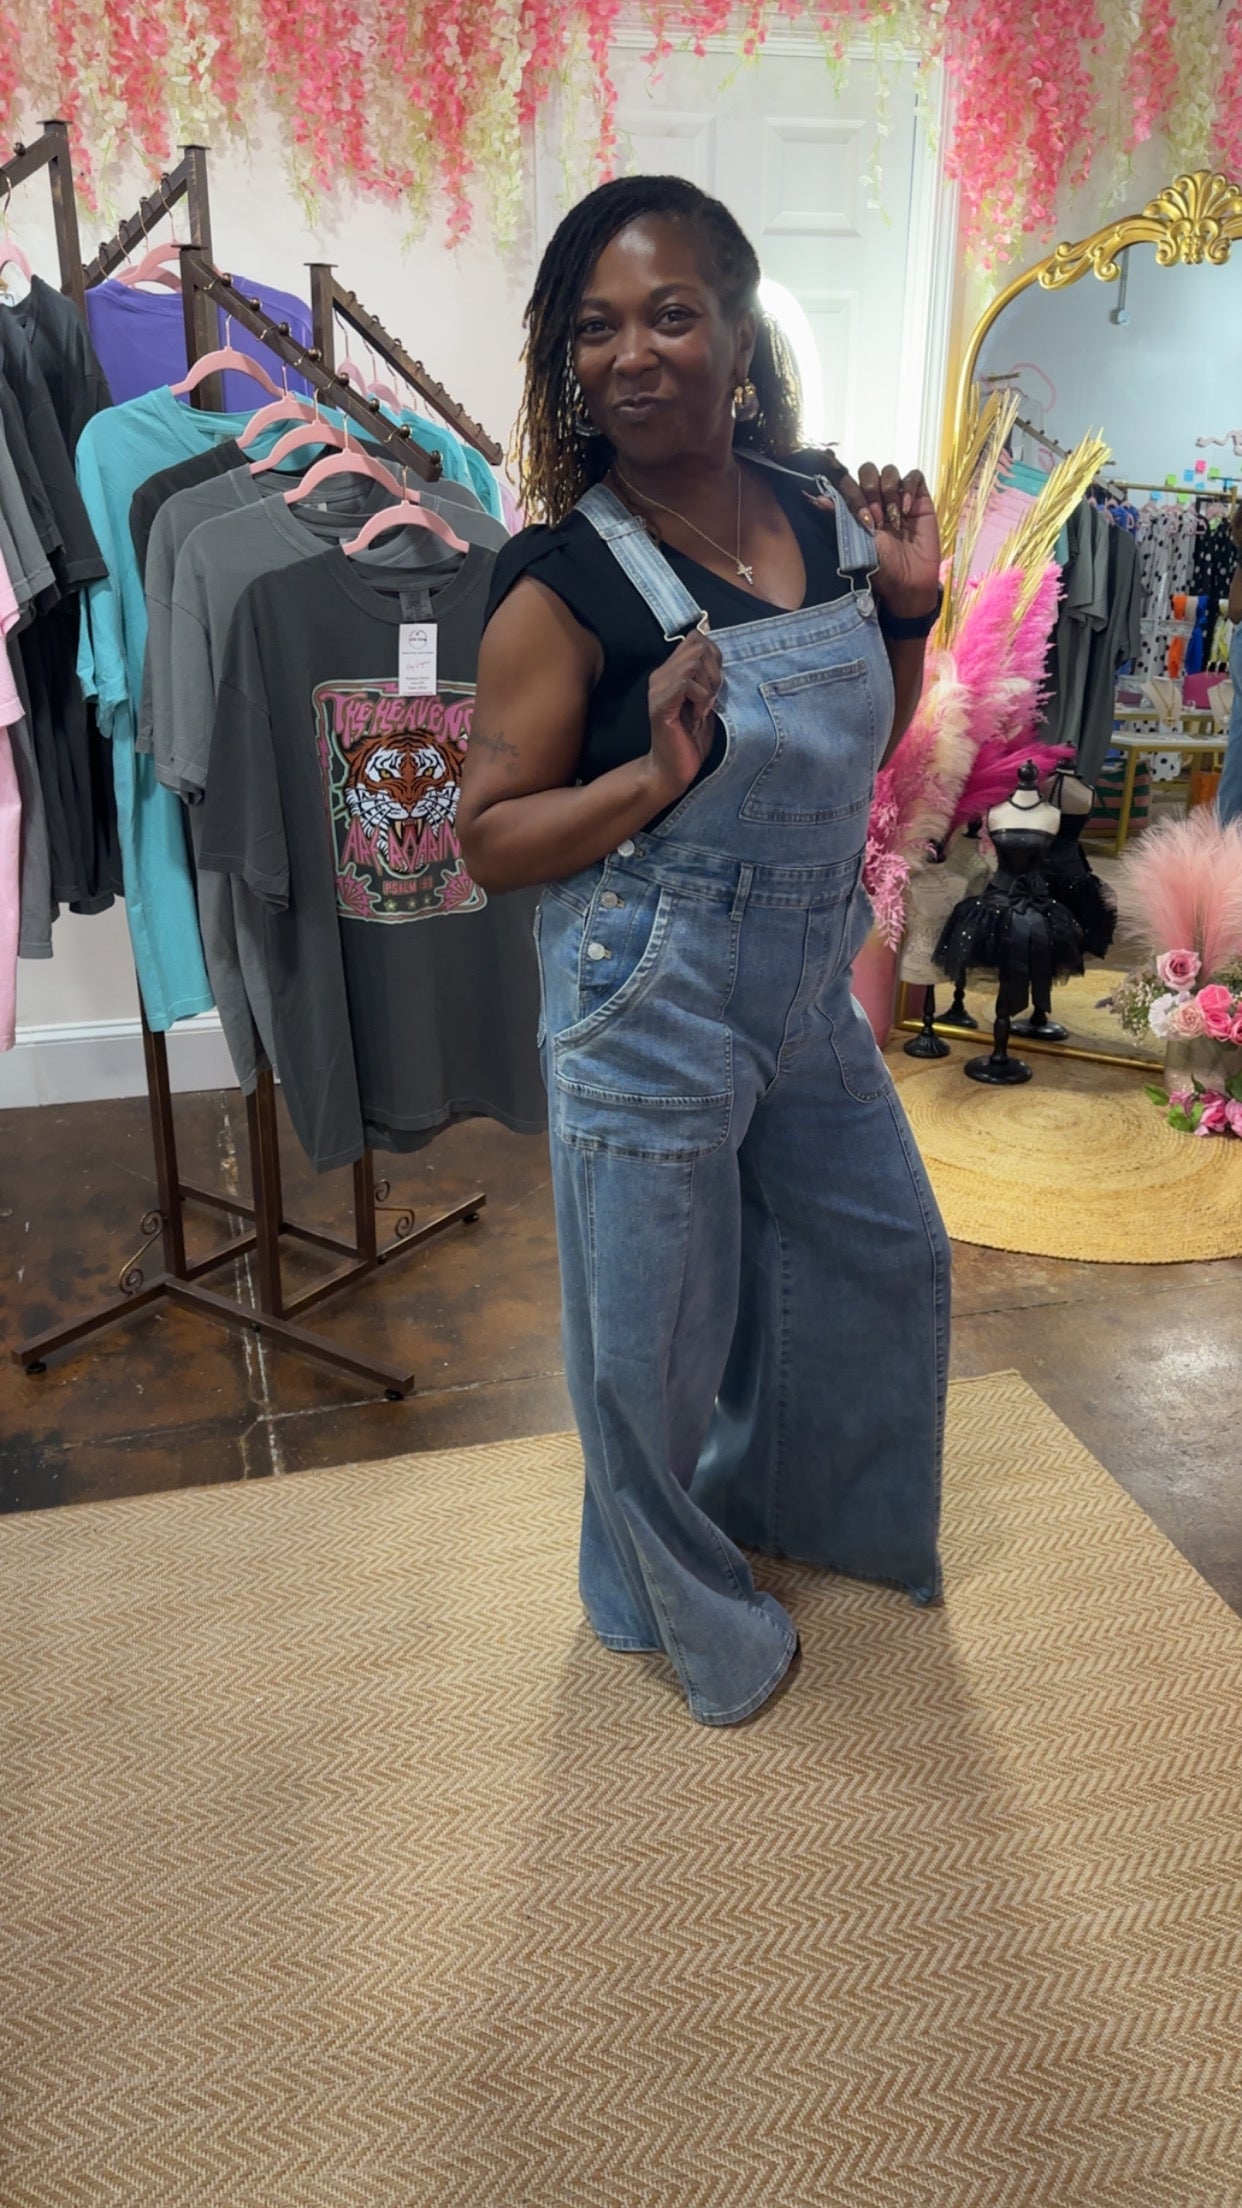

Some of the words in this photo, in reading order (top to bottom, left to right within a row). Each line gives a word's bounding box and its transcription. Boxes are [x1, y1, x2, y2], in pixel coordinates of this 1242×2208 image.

[318, 691, 372, 749] THE
[341, 816, 383, 876] ARE
[383, 881, 417, 896] PSALM
